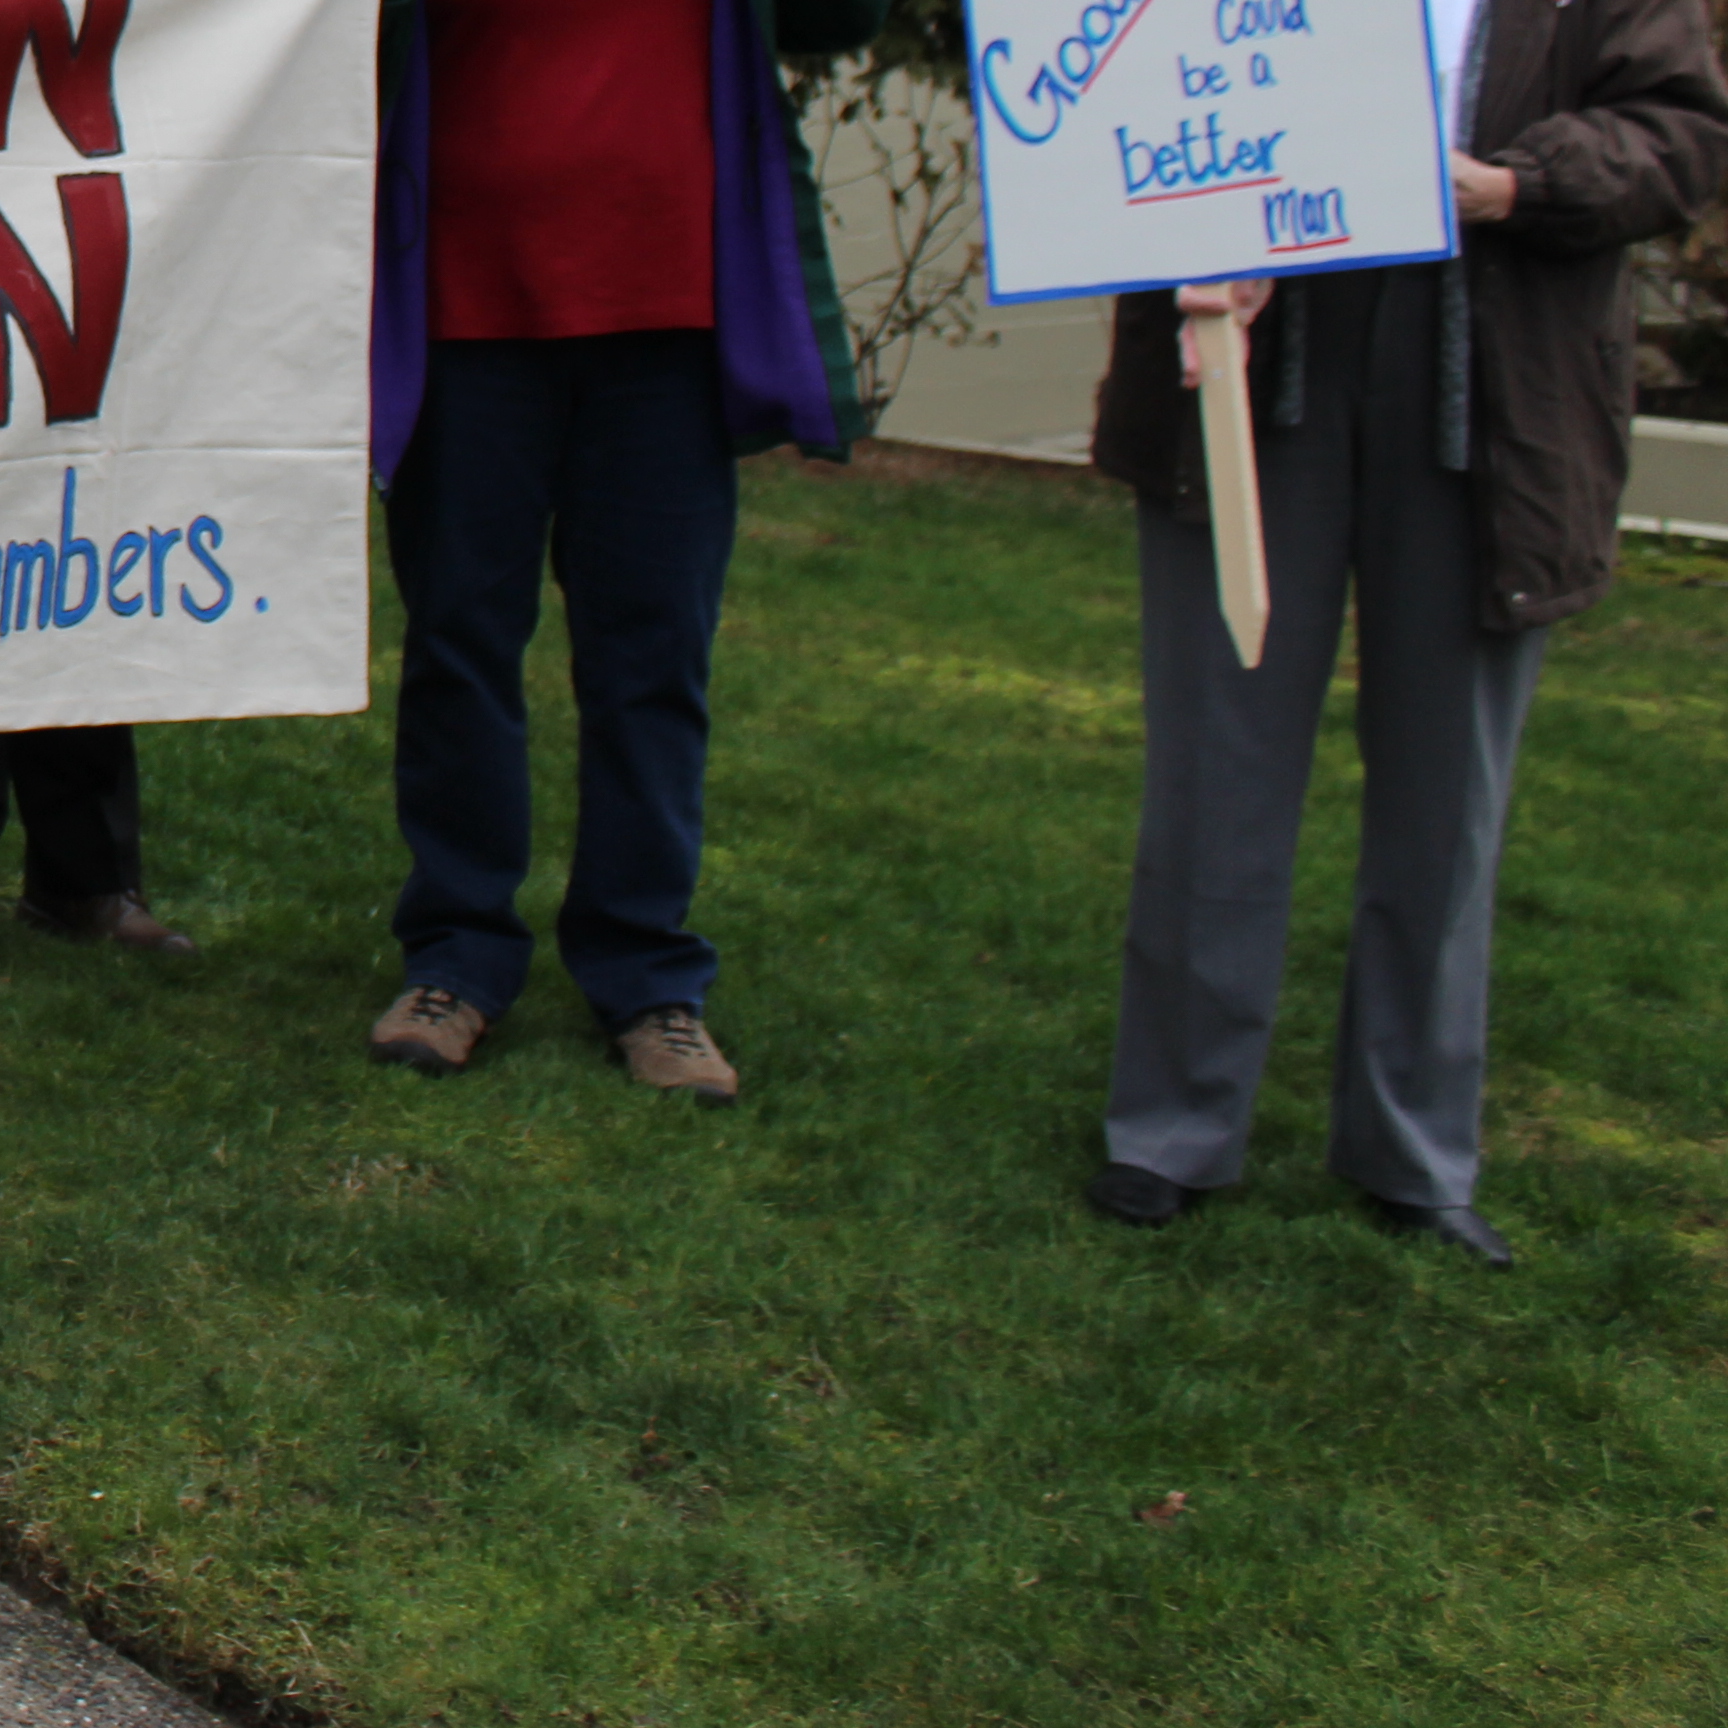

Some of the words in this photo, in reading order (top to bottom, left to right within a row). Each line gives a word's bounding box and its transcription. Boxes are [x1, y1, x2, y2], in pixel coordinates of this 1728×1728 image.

[1179, 55, 1232, 98] be
[1251, 54, 1276, 88] a
[1115, 112, 1287, 195] better
[1264, 188, 1349, 245] man
